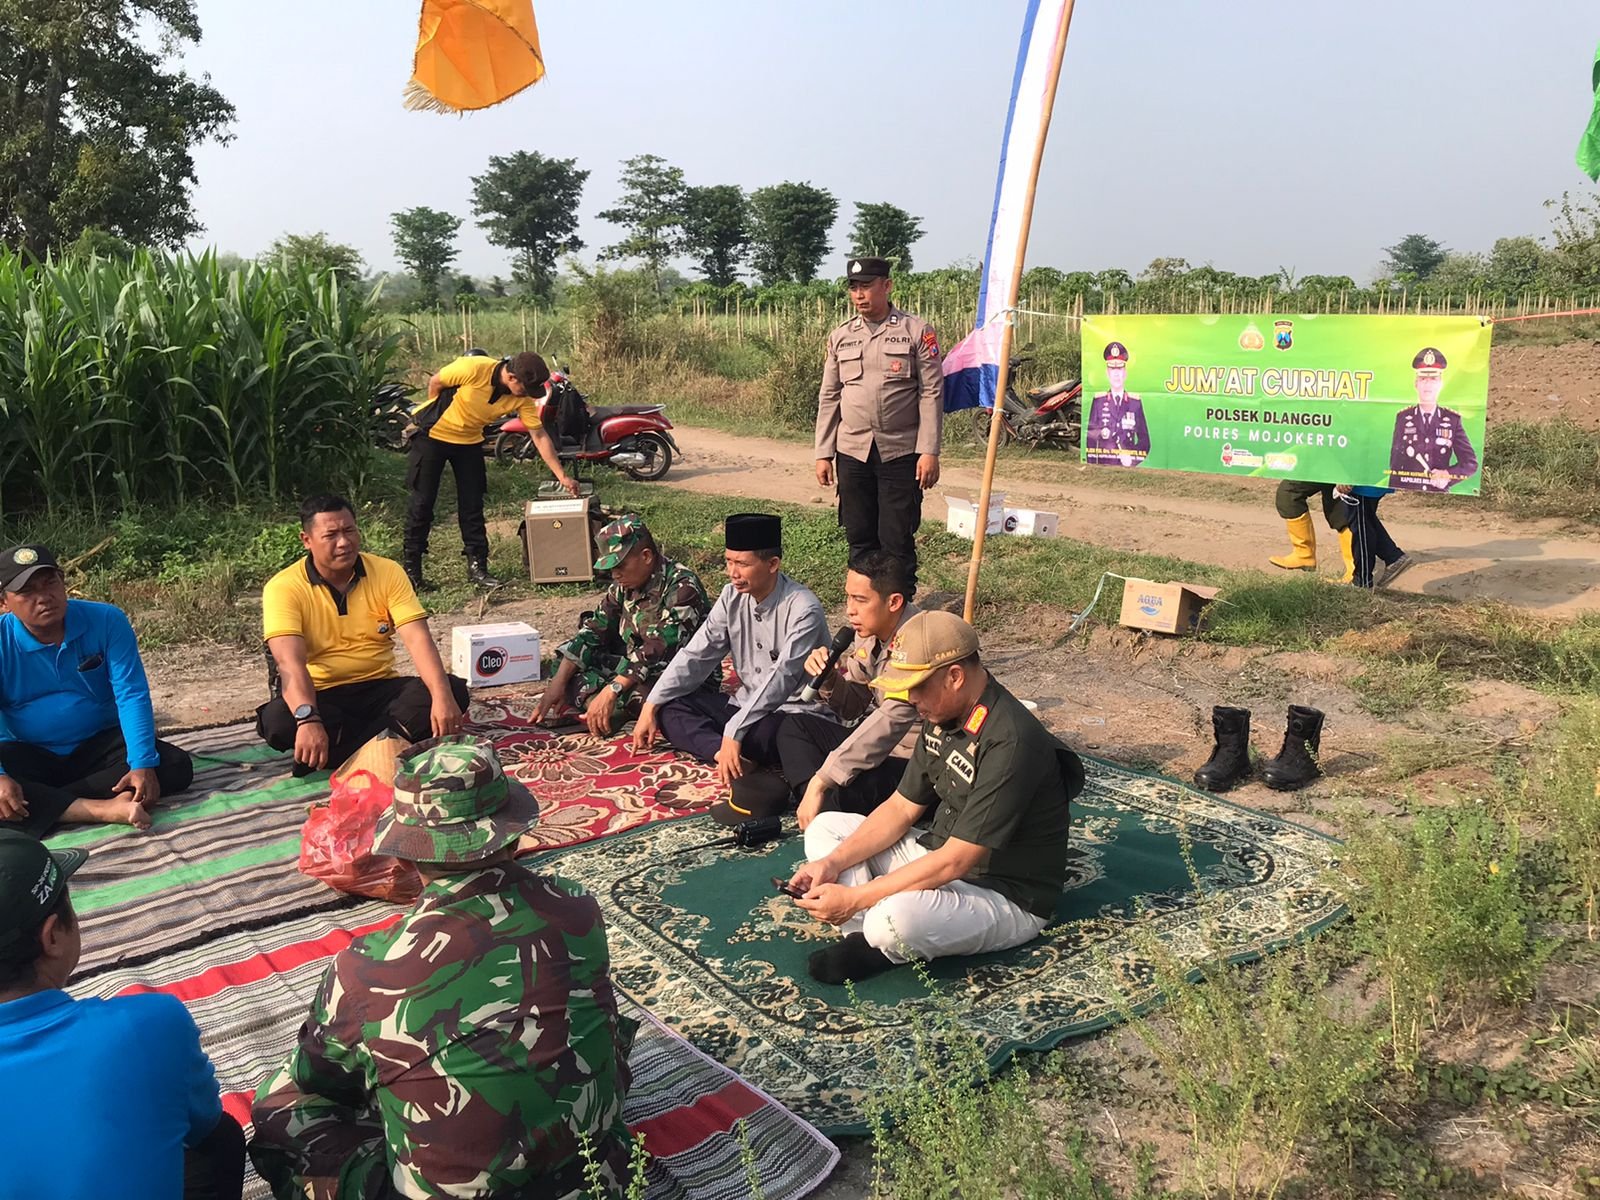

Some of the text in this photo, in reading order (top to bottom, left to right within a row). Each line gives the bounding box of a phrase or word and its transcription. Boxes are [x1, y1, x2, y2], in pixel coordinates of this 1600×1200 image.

[885, 336, 911, 344] POLRI
[1165, 366, 1373, 400] JUM'AT CURHAT
[1206, 408, 1332, 427] POLSEK DLANGGU
[1184, 425, 1348, 448] POLRES MOJOKERTO
[482, 656, 502, 669] Cleo
